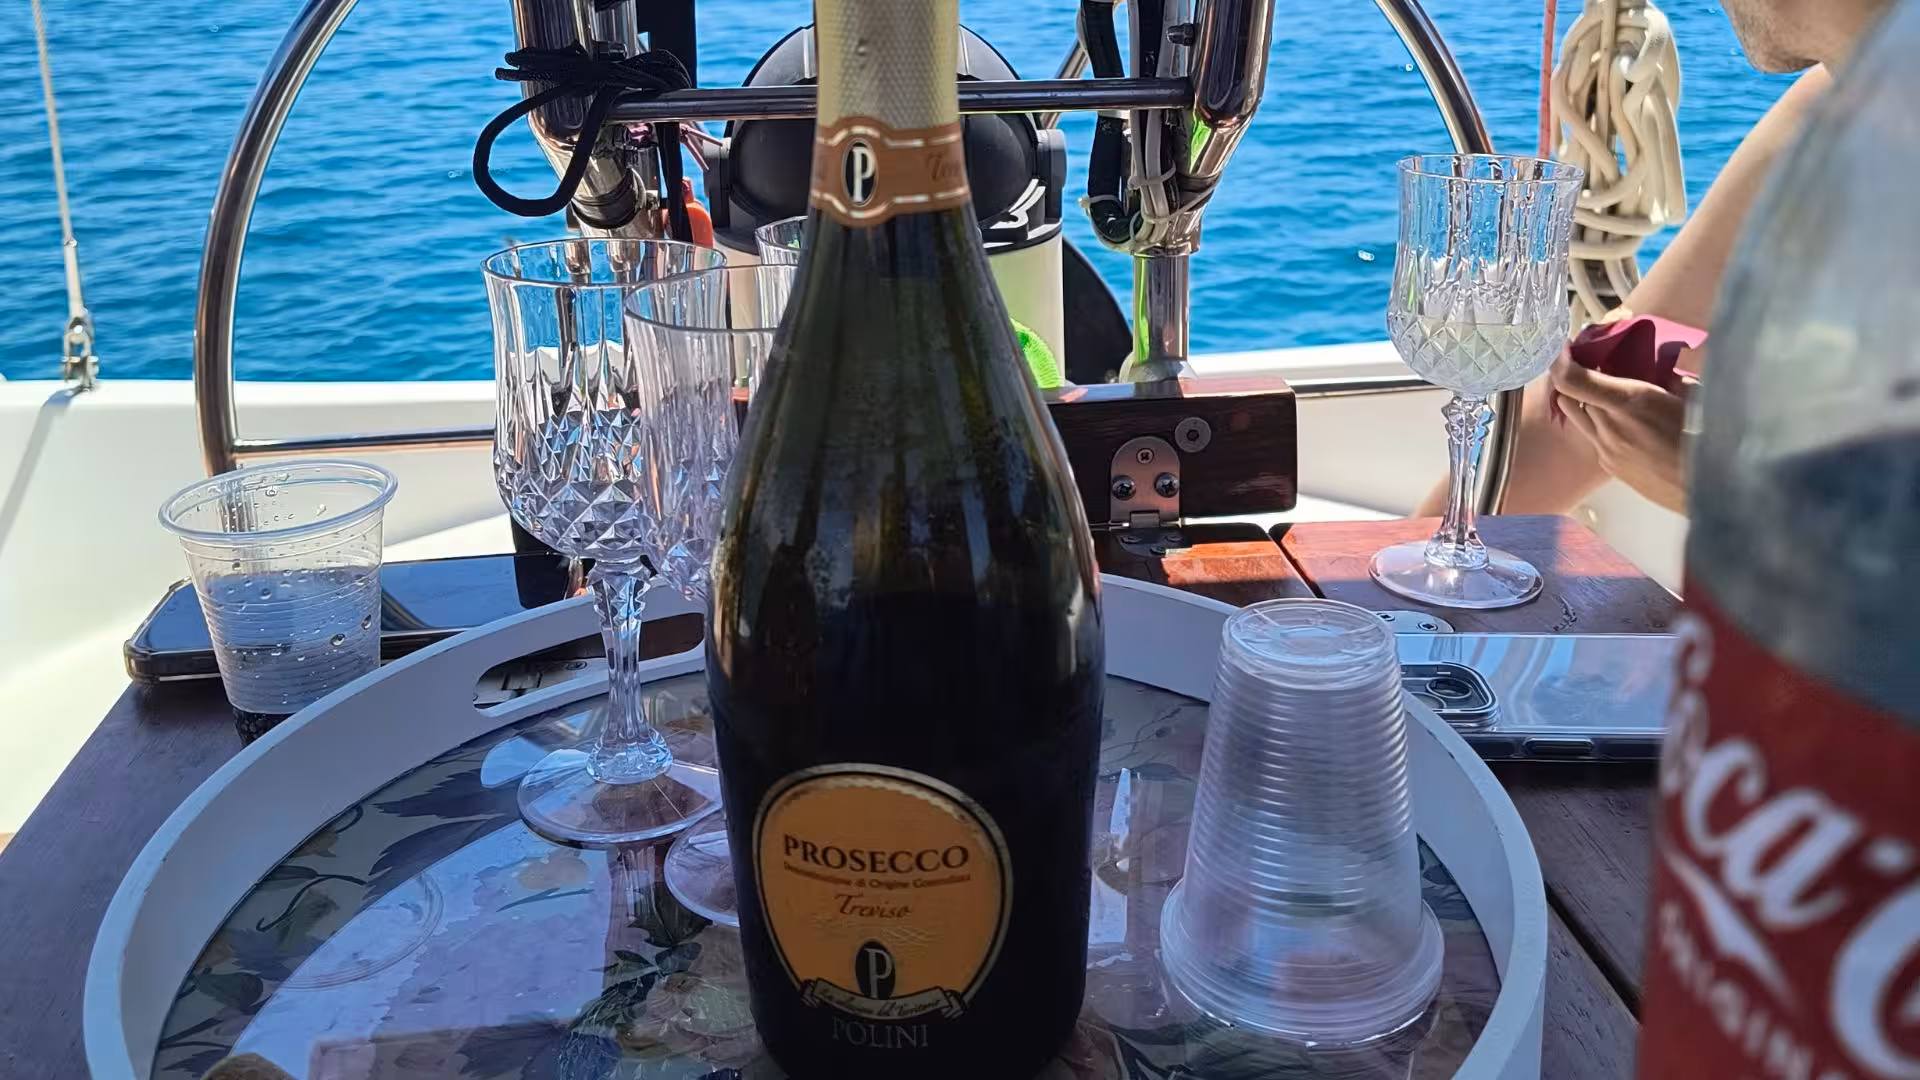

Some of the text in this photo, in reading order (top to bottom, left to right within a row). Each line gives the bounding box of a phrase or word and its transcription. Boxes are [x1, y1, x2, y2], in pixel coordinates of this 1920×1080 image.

[851, 145, 877, 203] P
[783, 833, 970, 874] PROSECCO
[833, 892, 913, 919] Treviso
[864, 946, 893, 998] P
[831, 1016, 930, 1049] POLINI
